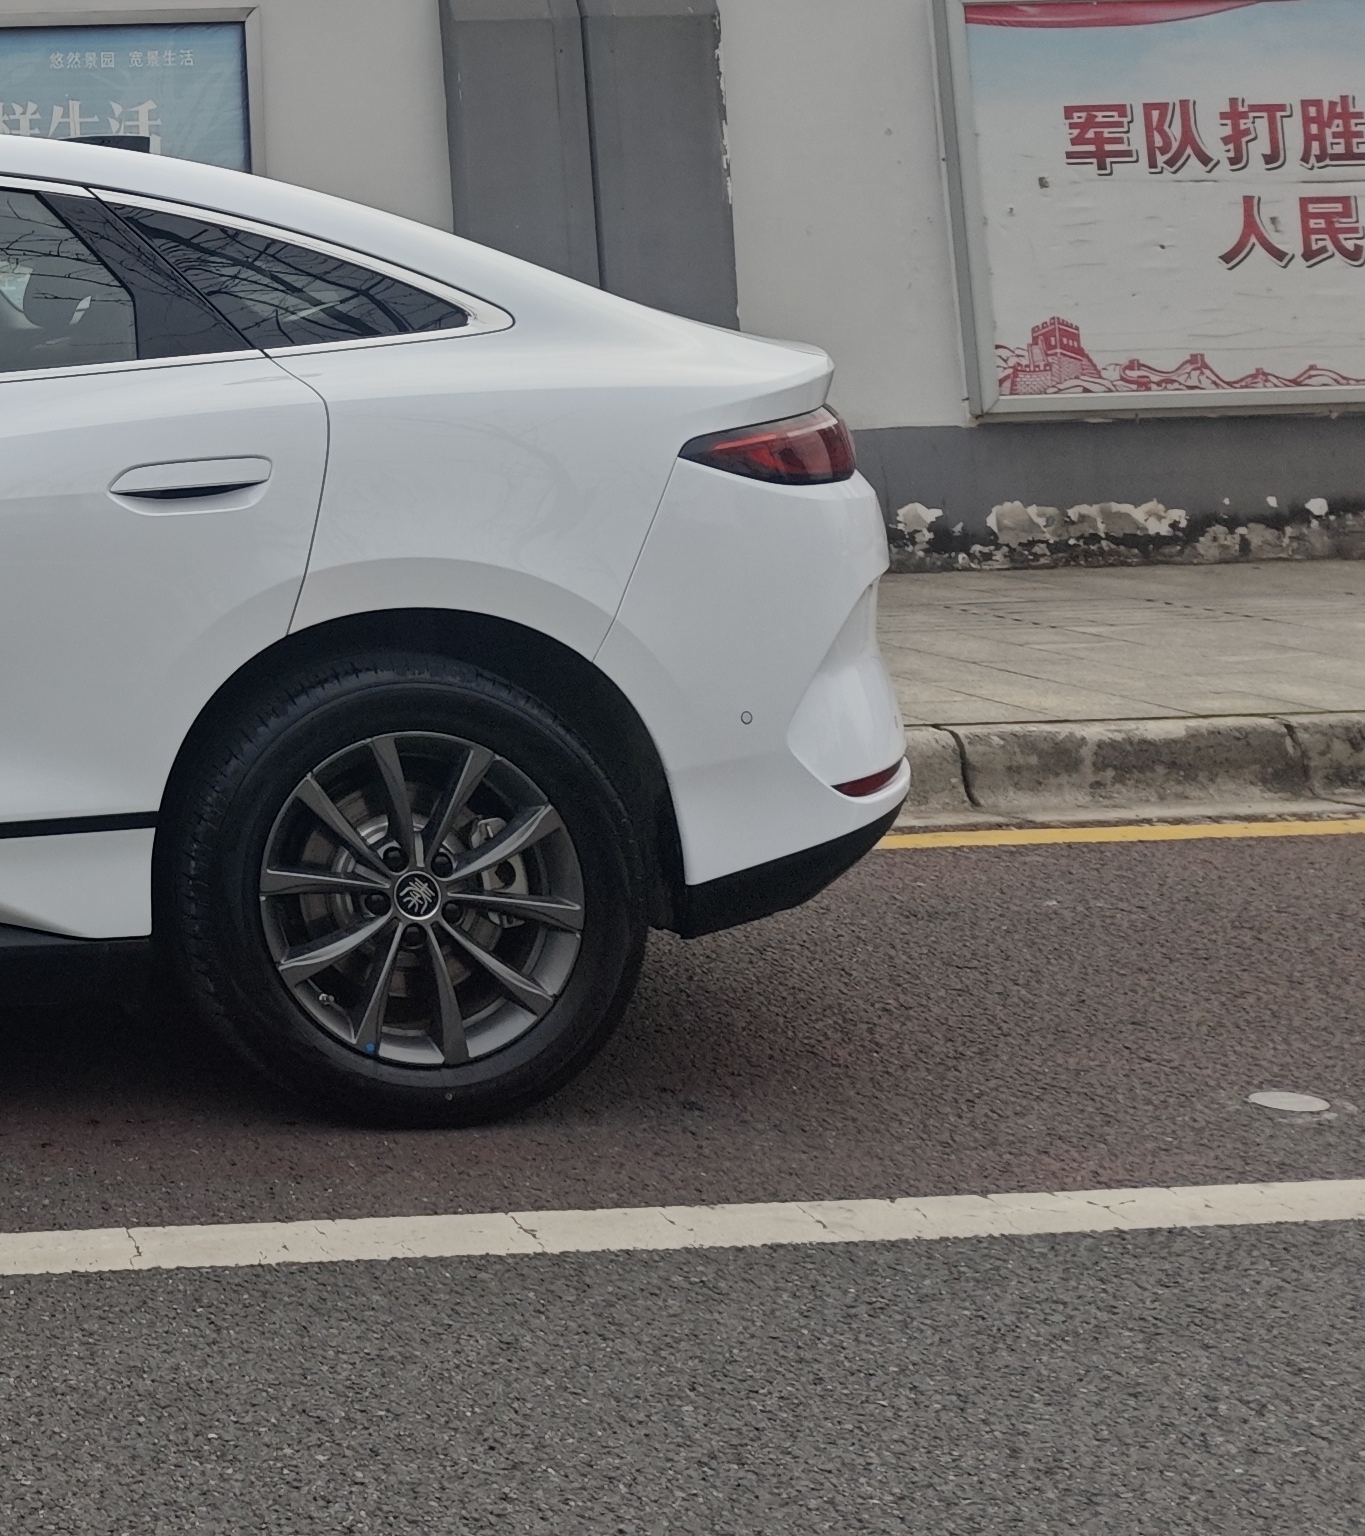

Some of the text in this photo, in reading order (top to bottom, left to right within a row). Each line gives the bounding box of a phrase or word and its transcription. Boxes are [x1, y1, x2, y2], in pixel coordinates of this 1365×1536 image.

[49, 49, 195, 69] 悠然景园 宽景生活
[1063, 94, 1365, 175] 军队打胜
[1218, 194, 1365, 270] 人民
